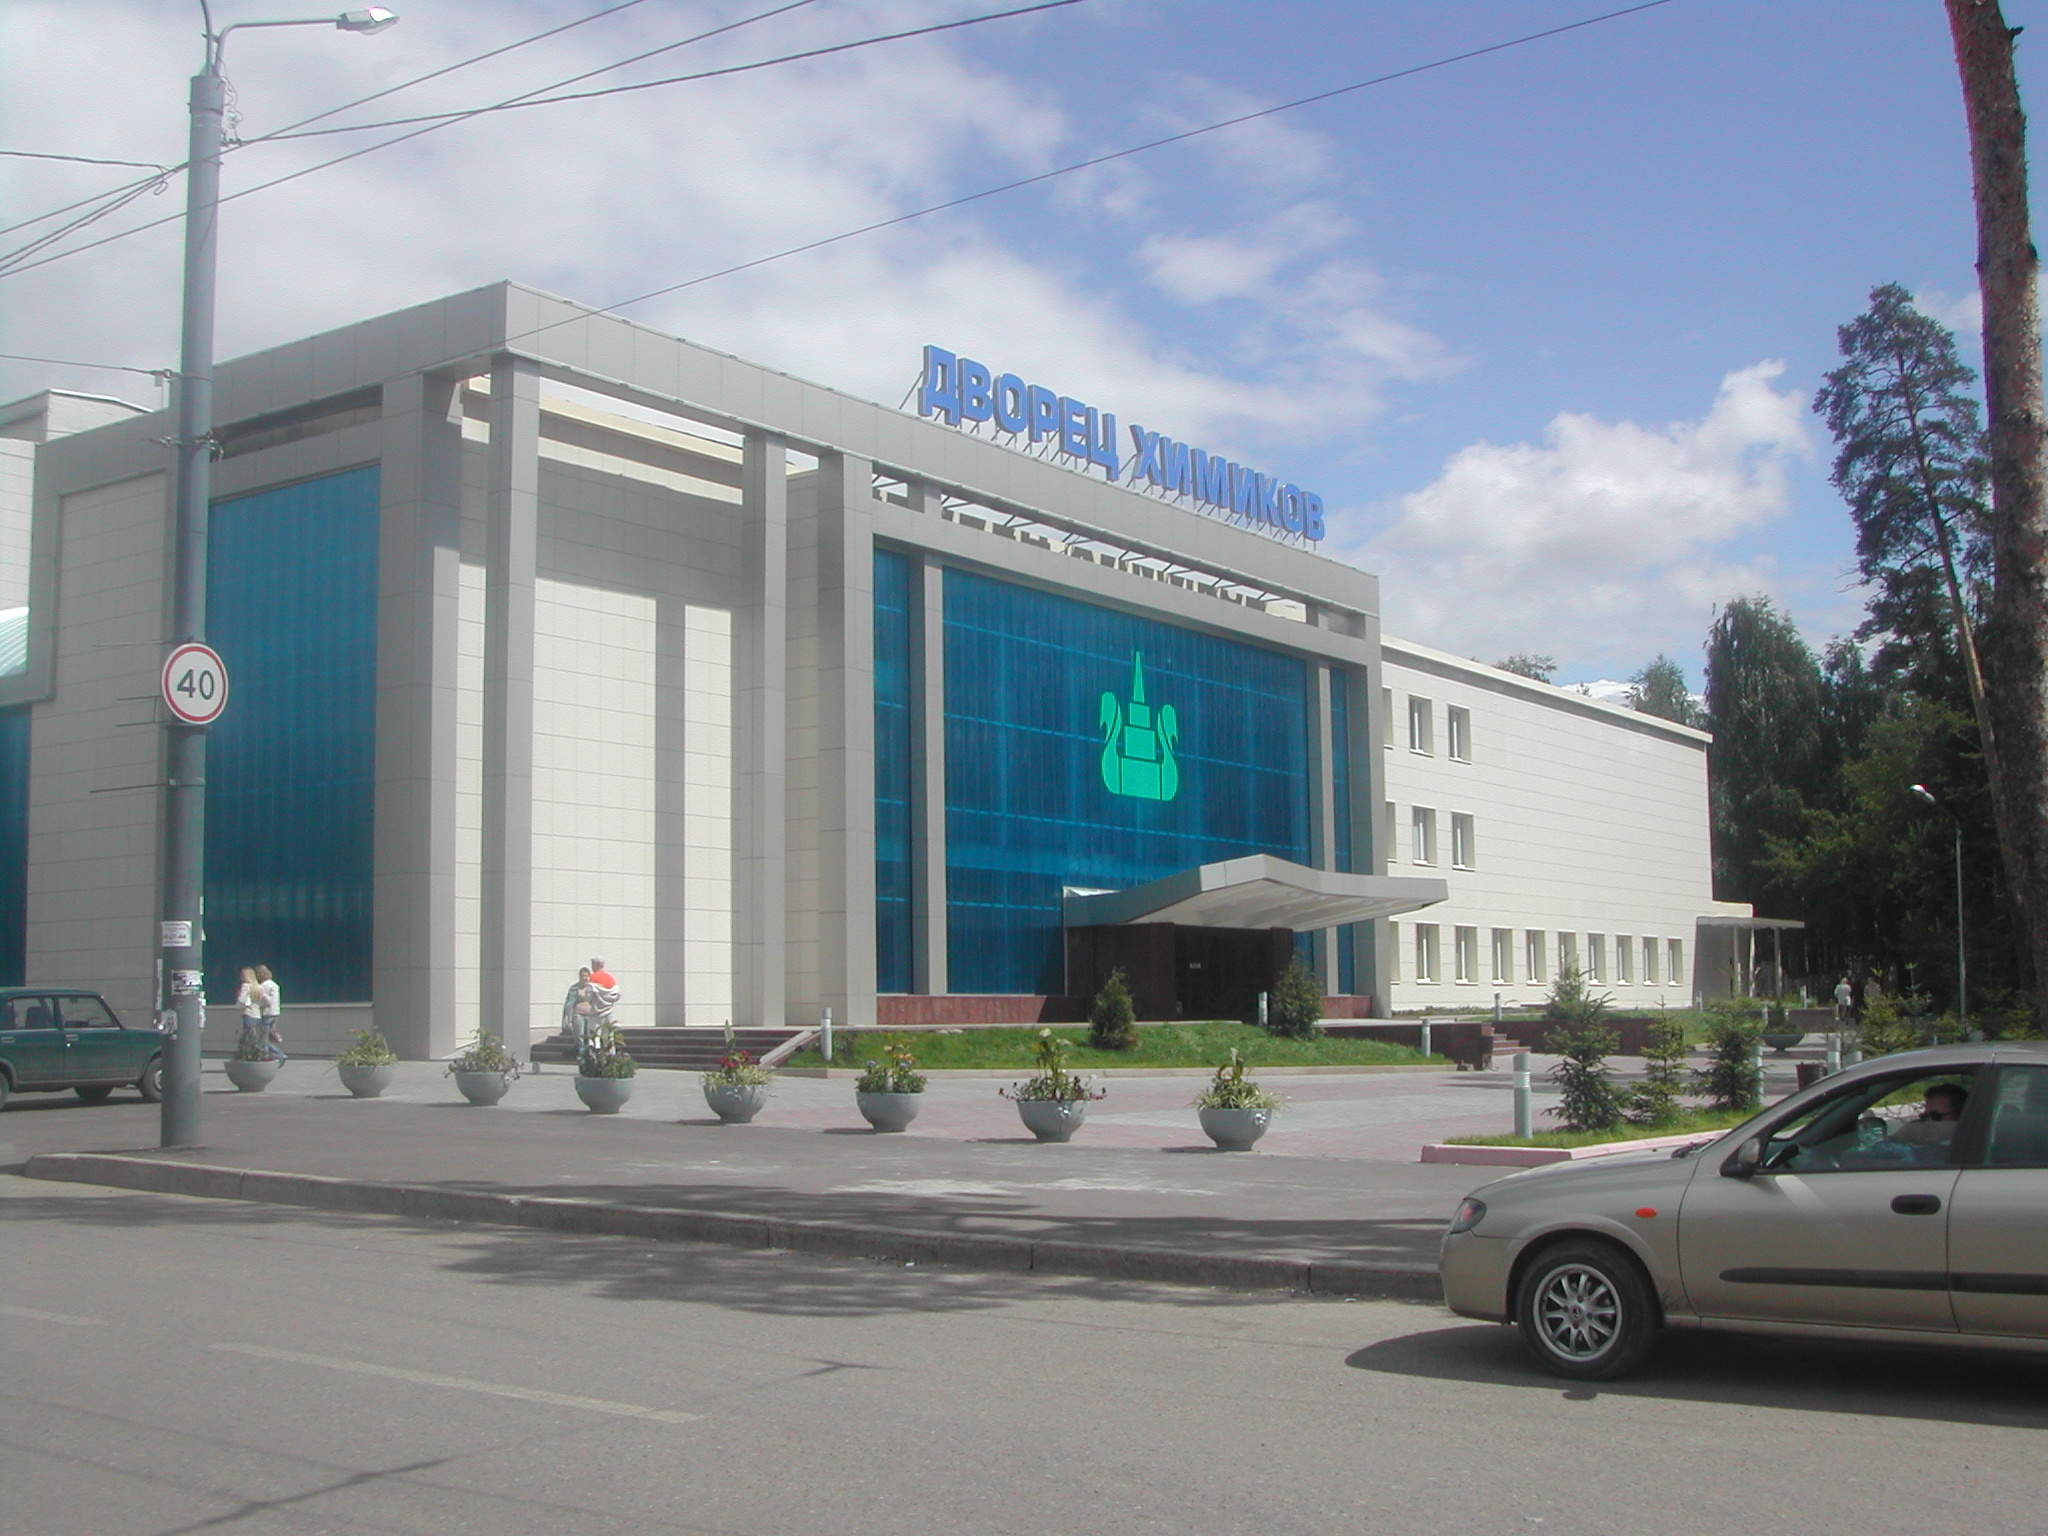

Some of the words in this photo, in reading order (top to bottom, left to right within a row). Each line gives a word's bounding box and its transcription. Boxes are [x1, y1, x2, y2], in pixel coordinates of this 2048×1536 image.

[917, 344, 1119, 482] ДВОРЕЦ
[1129, 424, 1326, 541] ХИМИКОВ
[177, 669, 214, 700] 40
